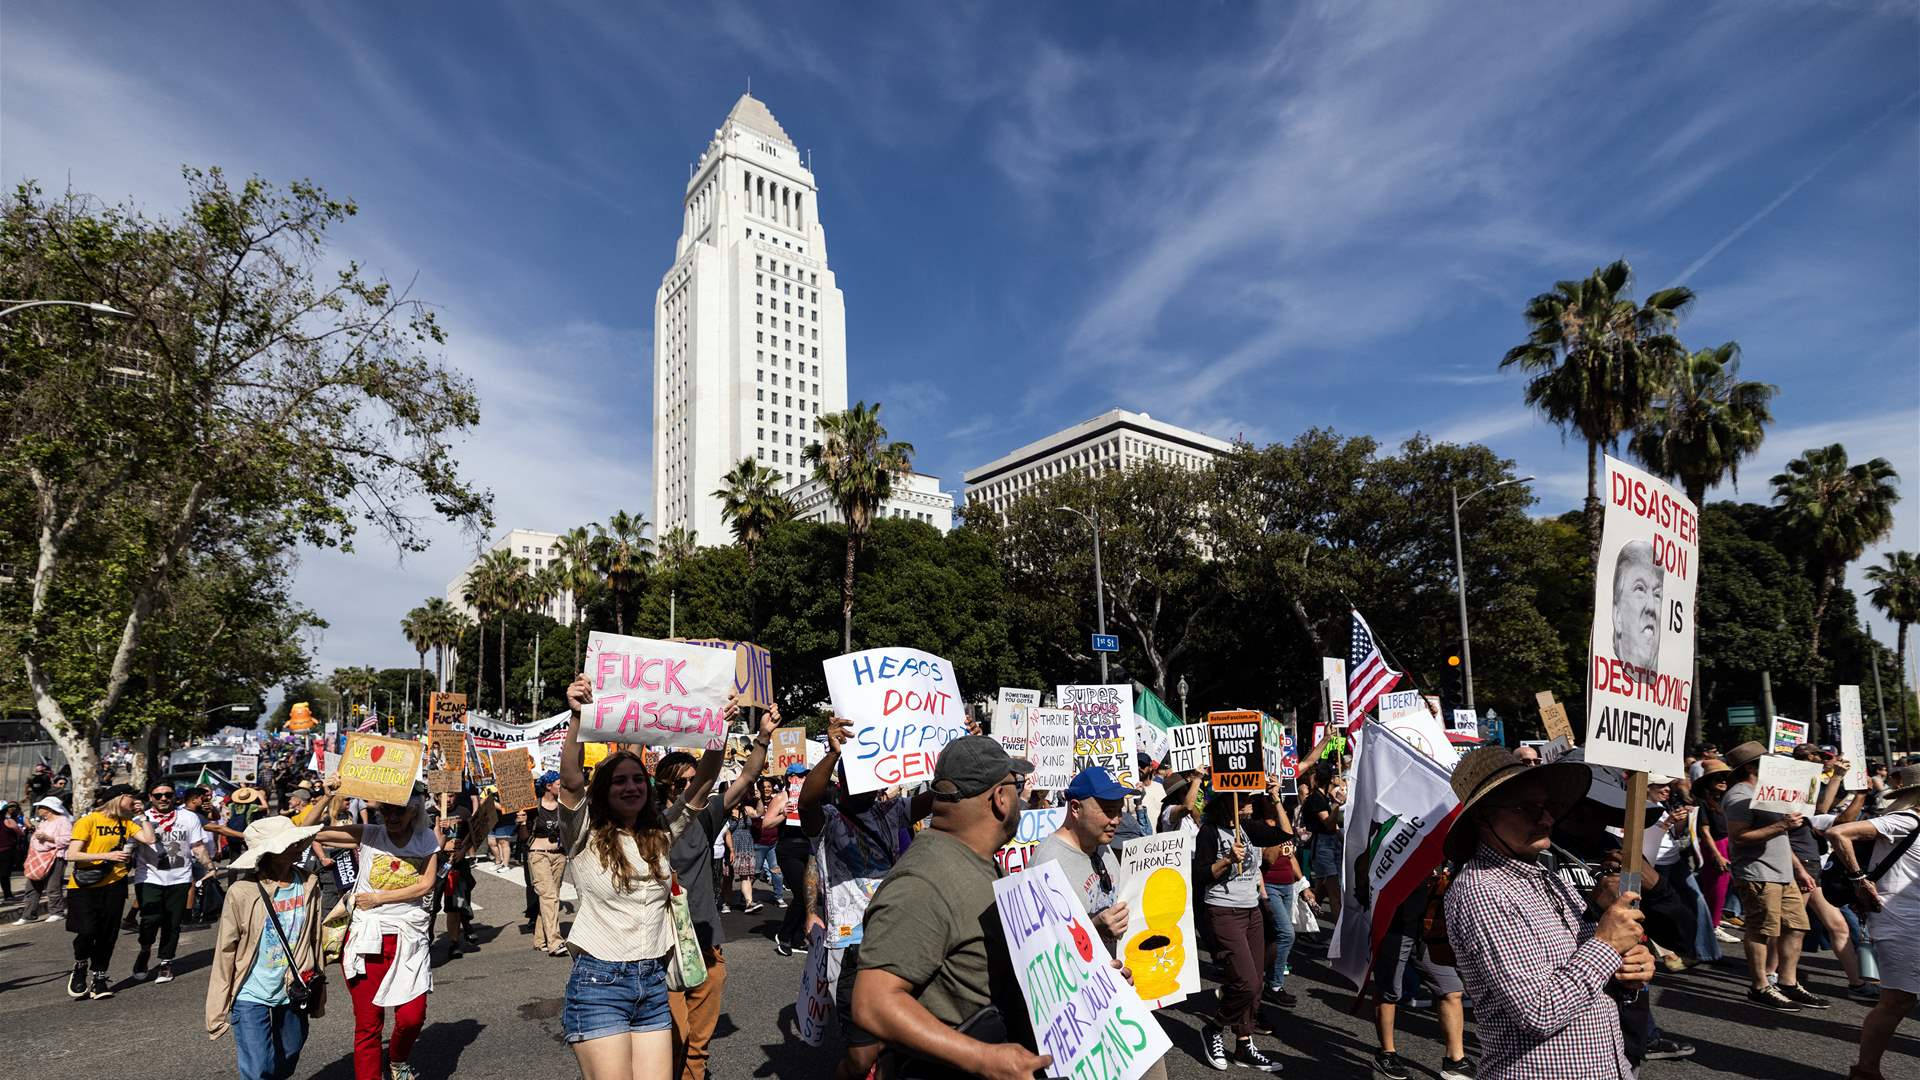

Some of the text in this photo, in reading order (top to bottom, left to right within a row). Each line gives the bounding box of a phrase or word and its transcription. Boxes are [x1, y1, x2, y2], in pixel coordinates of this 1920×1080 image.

[1611, 471, 1697, 546] DISASTER
[1652, 532, 1687, 580] DON
[1669, 599, 1683, 633] IS
[1106, 638, 1114, 648] St
[596, 653, 688, 696] FUCK
[852, 655, 943, 685] HEROS
[1594, 655, 1691, 714] DESTROYING
[883, 689, 952, 716] DONT
[1063, 703, 1119, 714] ALLOUS
[1381, 692, 1418, 711] LIBERTY
[432, 712, 462, 724] FUCK
[594, 694, 724, 736] FASCISM
[1030, 709, 1069, 727] NO THRONE
[1074, 714, 1120, 726] ASCIST
[469, 726, 525, 742] NO WAR
[778, 731, 801, 745] EAT
[1029, 730, 1069, 748] NO CROWN
[1076, 724, 1121, 739] ACIST
[1174, 727, 1194, 748] NO
[1212, 724, 1258, 740] TRUMP
[1595, 706, 1674, 754] AMERICA
[1002, 736, 1026, 744] FLUSH
[1218, 740, 1254, 754] MUST
[352, 740, 404, 762] WE THE
[1042, 754, 1065, 766] KING
[778, 754, 805, 768] RICH
[1228, 756, 1247, 770] GO
[1220, 774, 1260, 788] NOW!
[1125, 838, 1184, 858] NO GOLDEN
[336, 860, 349, 885] PROTEST
[344, 850, 358, 884] POWER
[1130, 852, 1182, 874] THRONES
[1026, 943, 1089, 1025] ATTACK
[1044, 965, 1118, 1078] THEIR OWN
